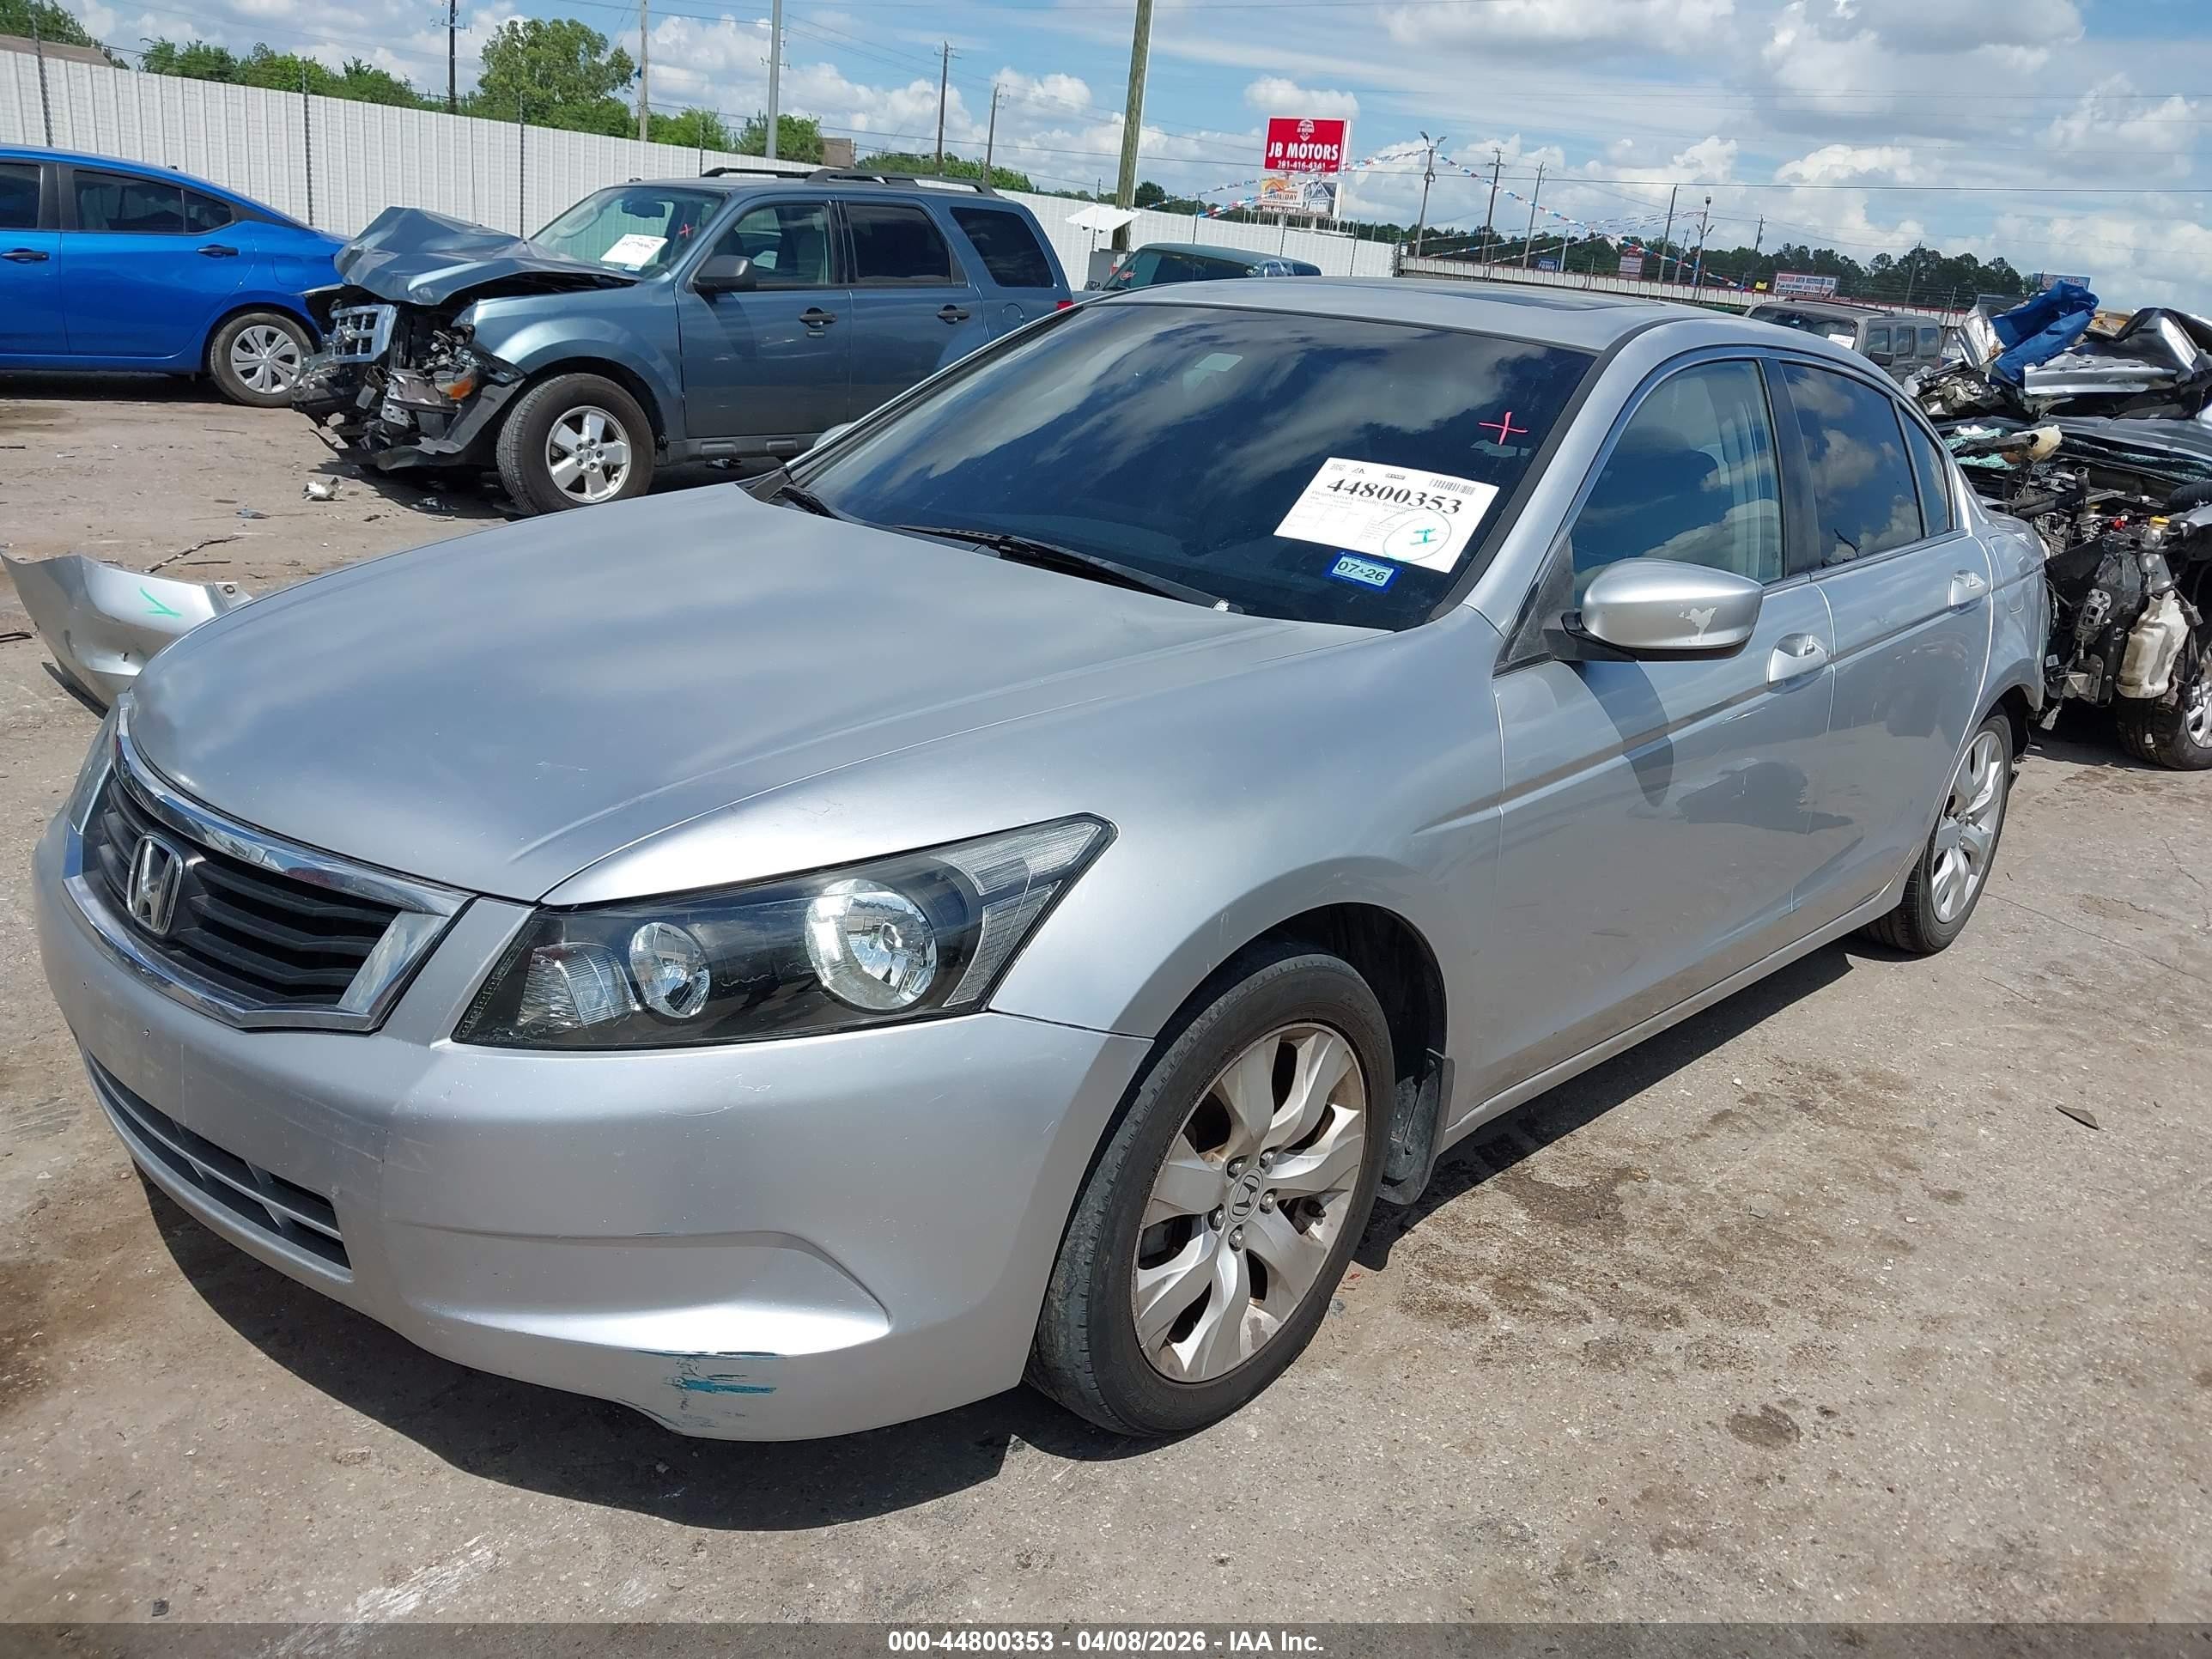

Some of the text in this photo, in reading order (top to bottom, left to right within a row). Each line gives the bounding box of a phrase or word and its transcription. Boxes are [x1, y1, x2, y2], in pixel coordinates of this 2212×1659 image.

[1268, 142, 1339, 161] JB MOTORS
[1327, 478, 1462, 514] 44800353
[1337, 561, 1387, 581] 07 26
